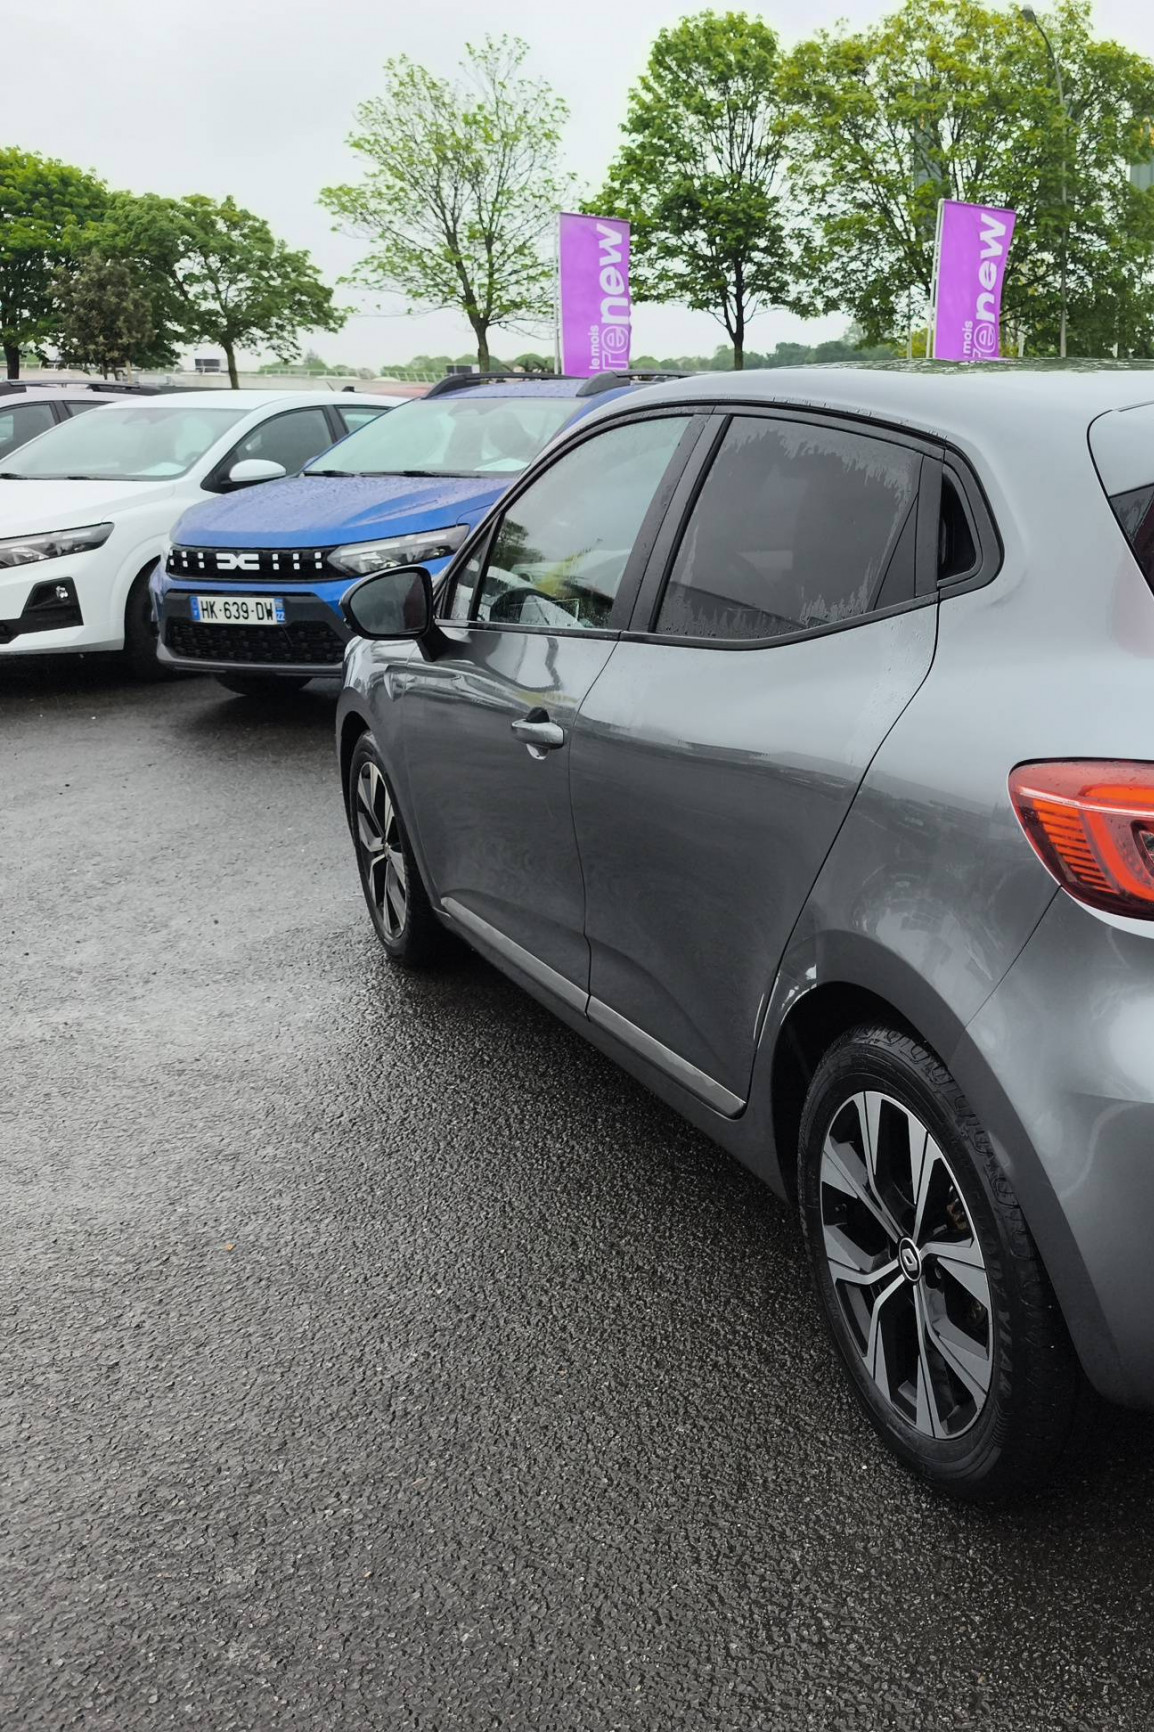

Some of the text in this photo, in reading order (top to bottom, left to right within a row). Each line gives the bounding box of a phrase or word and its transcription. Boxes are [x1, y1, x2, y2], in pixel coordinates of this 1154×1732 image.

[597, 223, 629, 370] renew
[587, 325, 600, 369] le mois
[961, 320, 973, 354] mois
